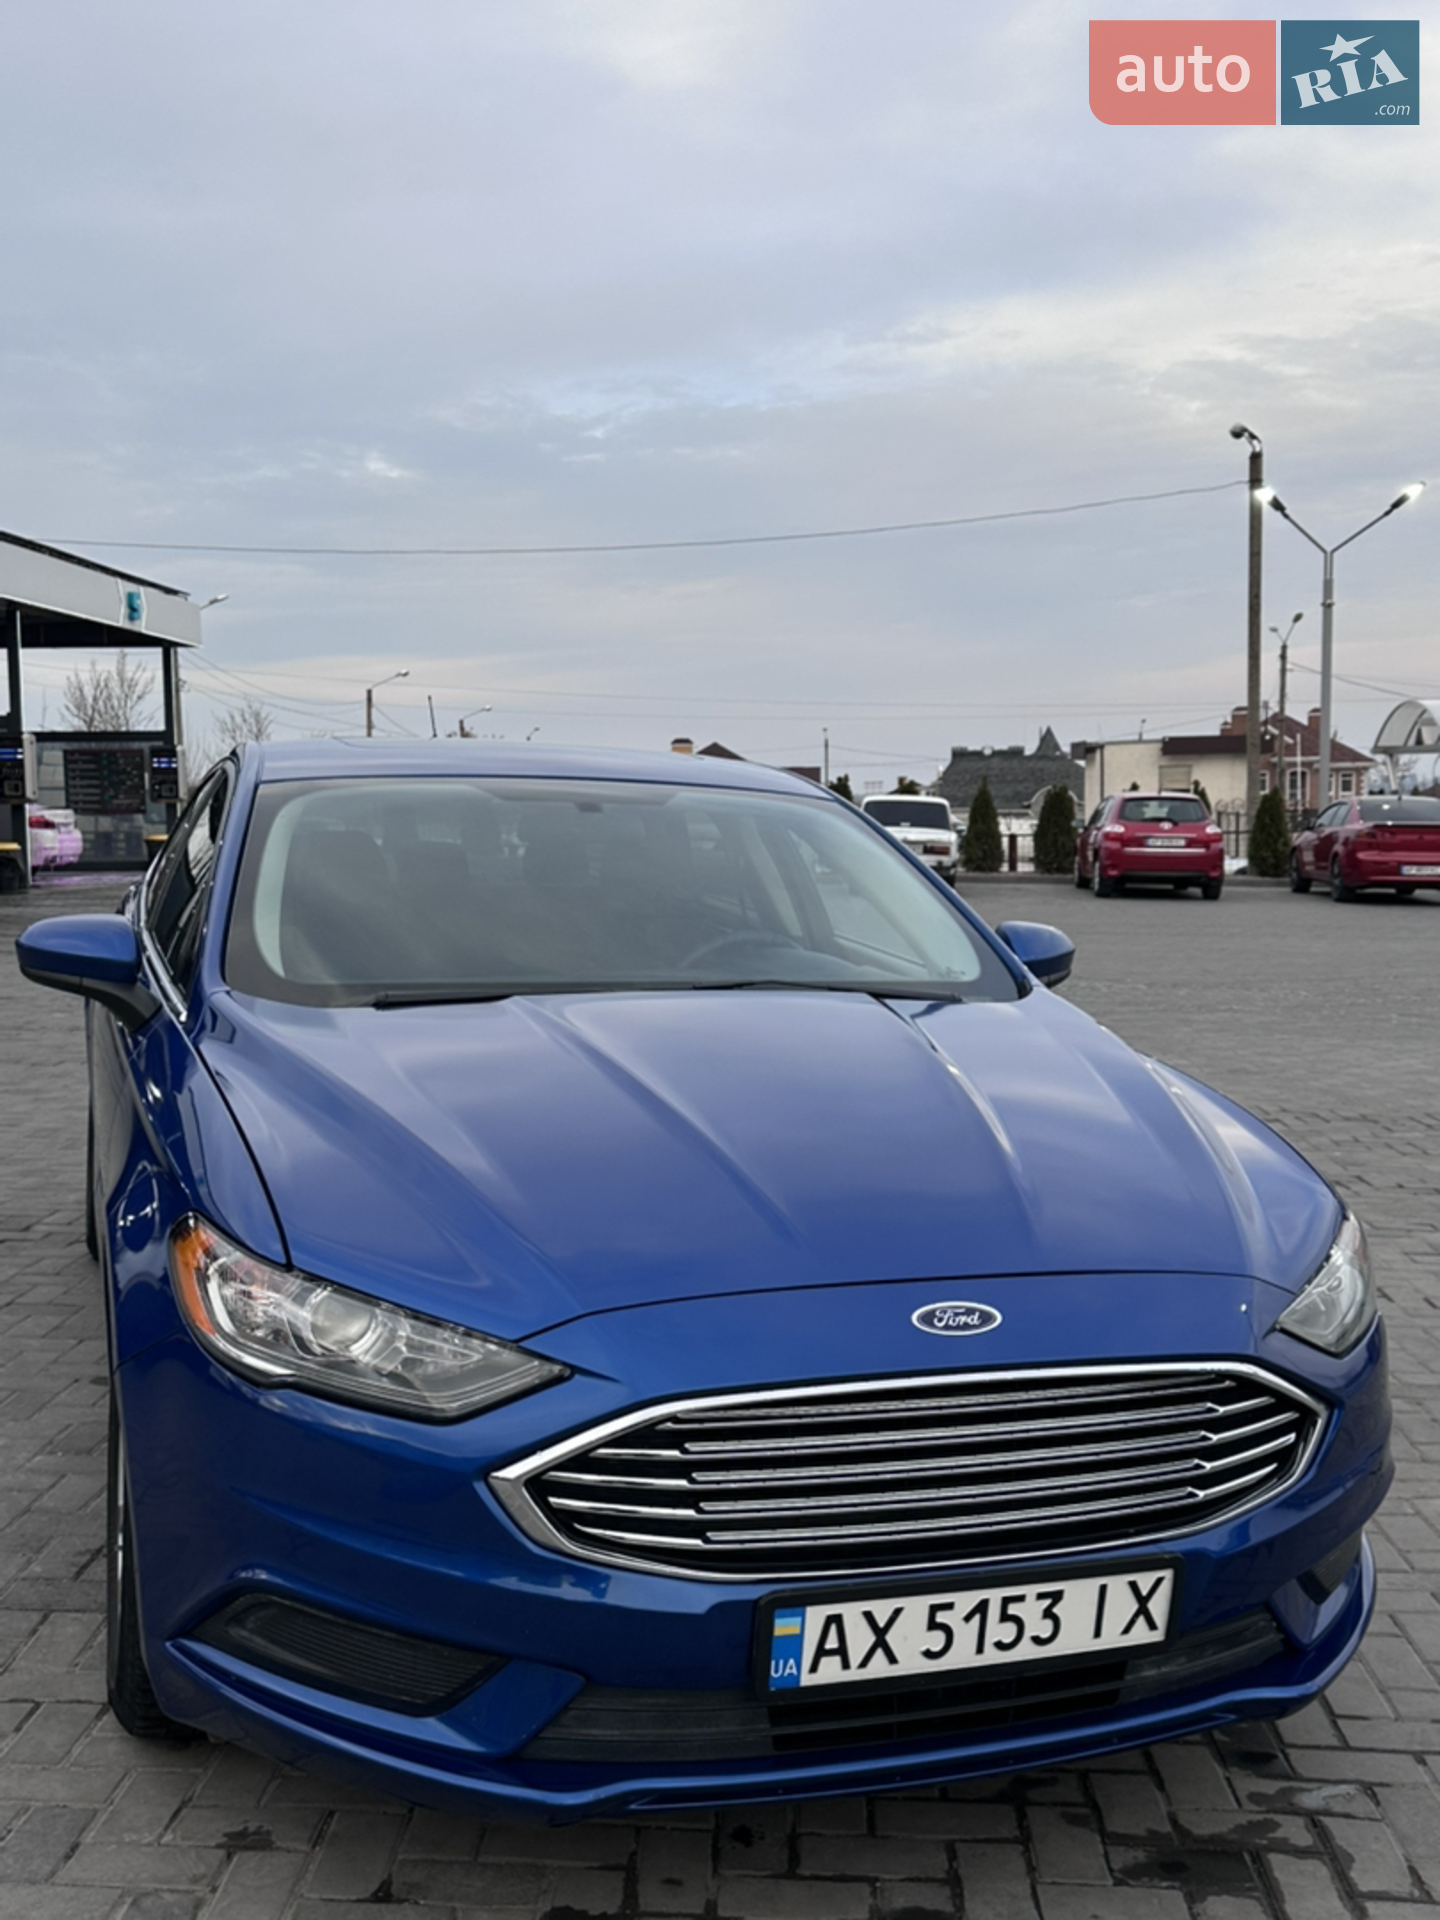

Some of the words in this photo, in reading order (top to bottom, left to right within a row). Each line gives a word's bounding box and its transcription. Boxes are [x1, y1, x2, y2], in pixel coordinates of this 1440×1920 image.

[933, 1307, 982, 1327] Ford
[808, 1606, 905, 1674] AX
[919, 1589, 1065, 1661] 5153
[1092, 1576, 1166, 1639] IX
[770, 1658, 798, 1678] UA
